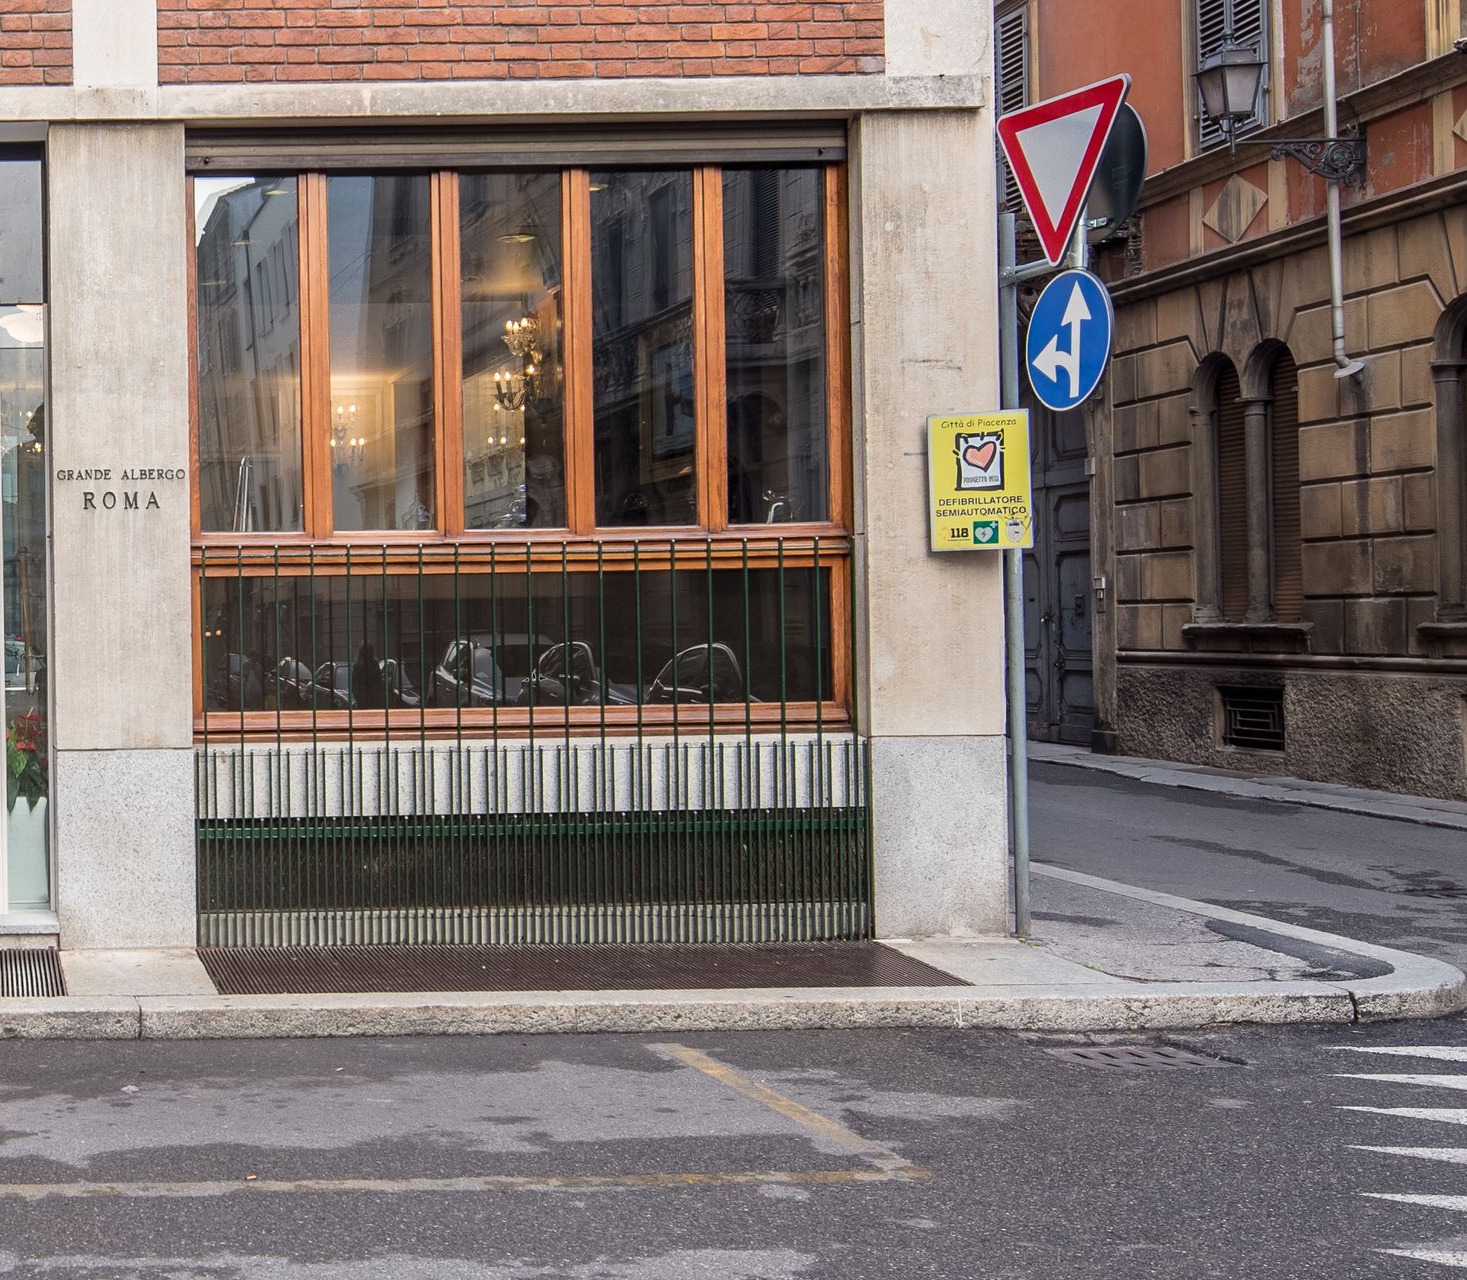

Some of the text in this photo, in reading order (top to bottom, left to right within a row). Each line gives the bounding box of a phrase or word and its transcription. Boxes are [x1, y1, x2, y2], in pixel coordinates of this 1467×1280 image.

[941, 420, 964, 429] Città
[977, 418, 1017, 427] Piacenza
[57, 468, 186, 481] GRANDE ALBERGO
[83, 491, 160, 510] ROMA
[939, 495, 1023, 506] DEFIBRILLATORE
[936, 506, 1026, 517] SEMIAUTOMATICO
[950, 527, 969, 539] 118
